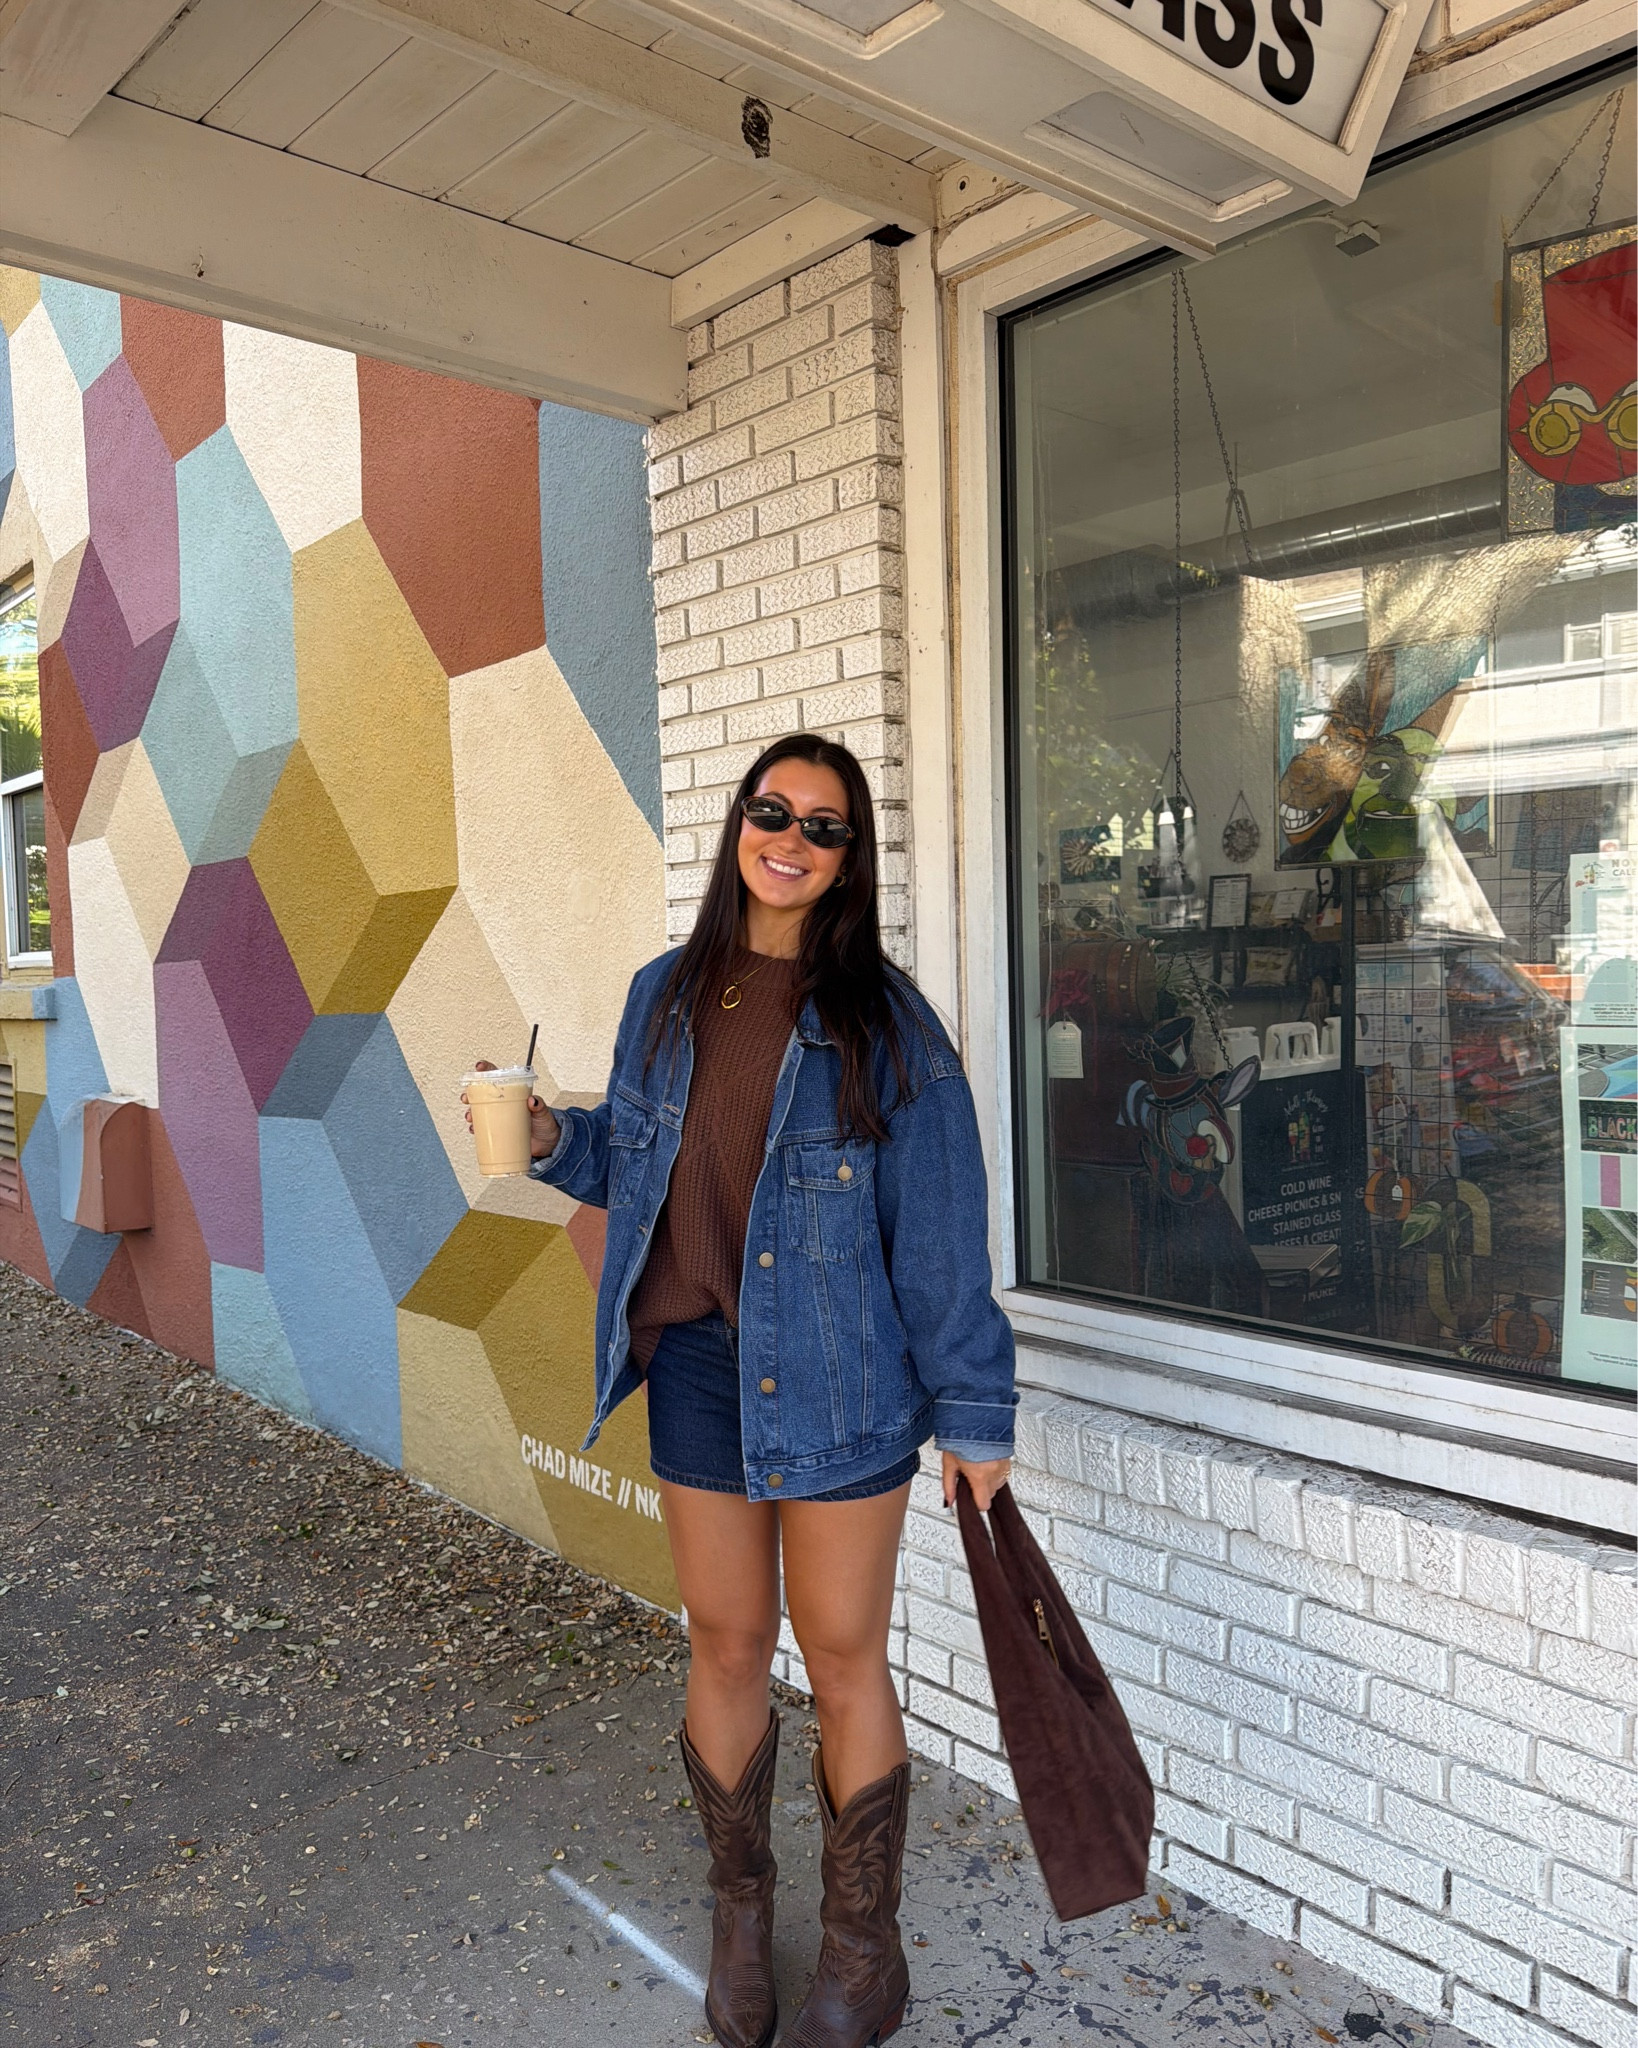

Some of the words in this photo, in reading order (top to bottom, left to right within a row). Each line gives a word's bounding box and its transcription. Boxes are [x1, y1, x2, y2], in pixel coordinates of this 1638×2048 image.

[1588, 1116, 1637, 1139] BLACK
[1280, 1181, 1305, 1196] COLD
[1307, 1176, 1332, 1190] WINE
[1248, 1203, 1282, 1222] CHEESE
[1284, 1196, 1320, 1214] PICNICS
[1321, 1193, 1328, 1206] &
[1273, 1217, 1311, 1235] STAINED
[1313, 1210, 1341, 1226] GLASS
[521, 1434, 566, 1480] CHAD
[569, 1454, 613, 1502] MIZE
[635, 1483, 663, 1523] NK
